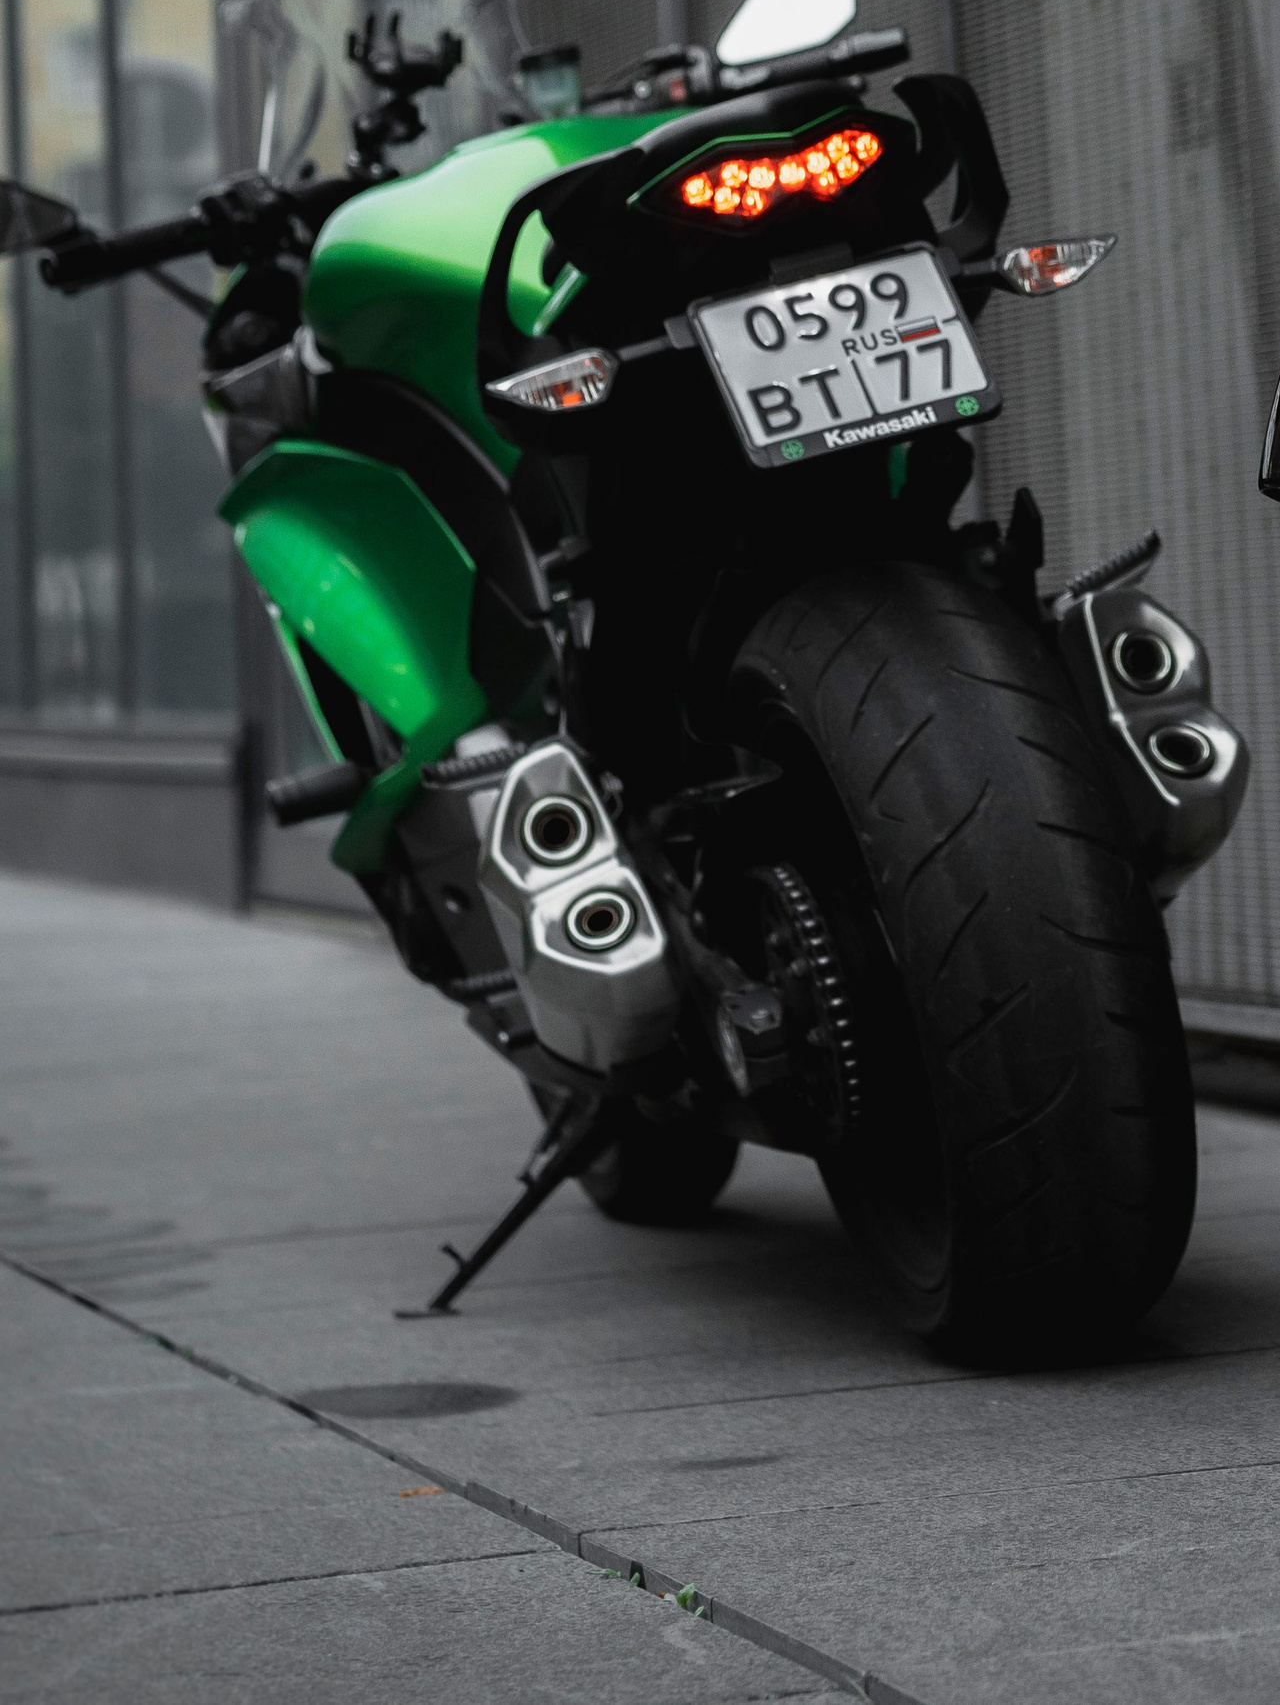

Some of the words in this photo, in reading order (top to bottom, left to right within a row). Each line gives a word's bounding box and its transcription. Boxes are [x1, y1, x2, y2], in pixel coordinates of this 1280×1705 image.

[746, 273, 908, 351] 0599
[841, 329, 897, 357] RUS
[875, 340, 951, 401] 77
[823, 407, 937, 448] Kawasaki
